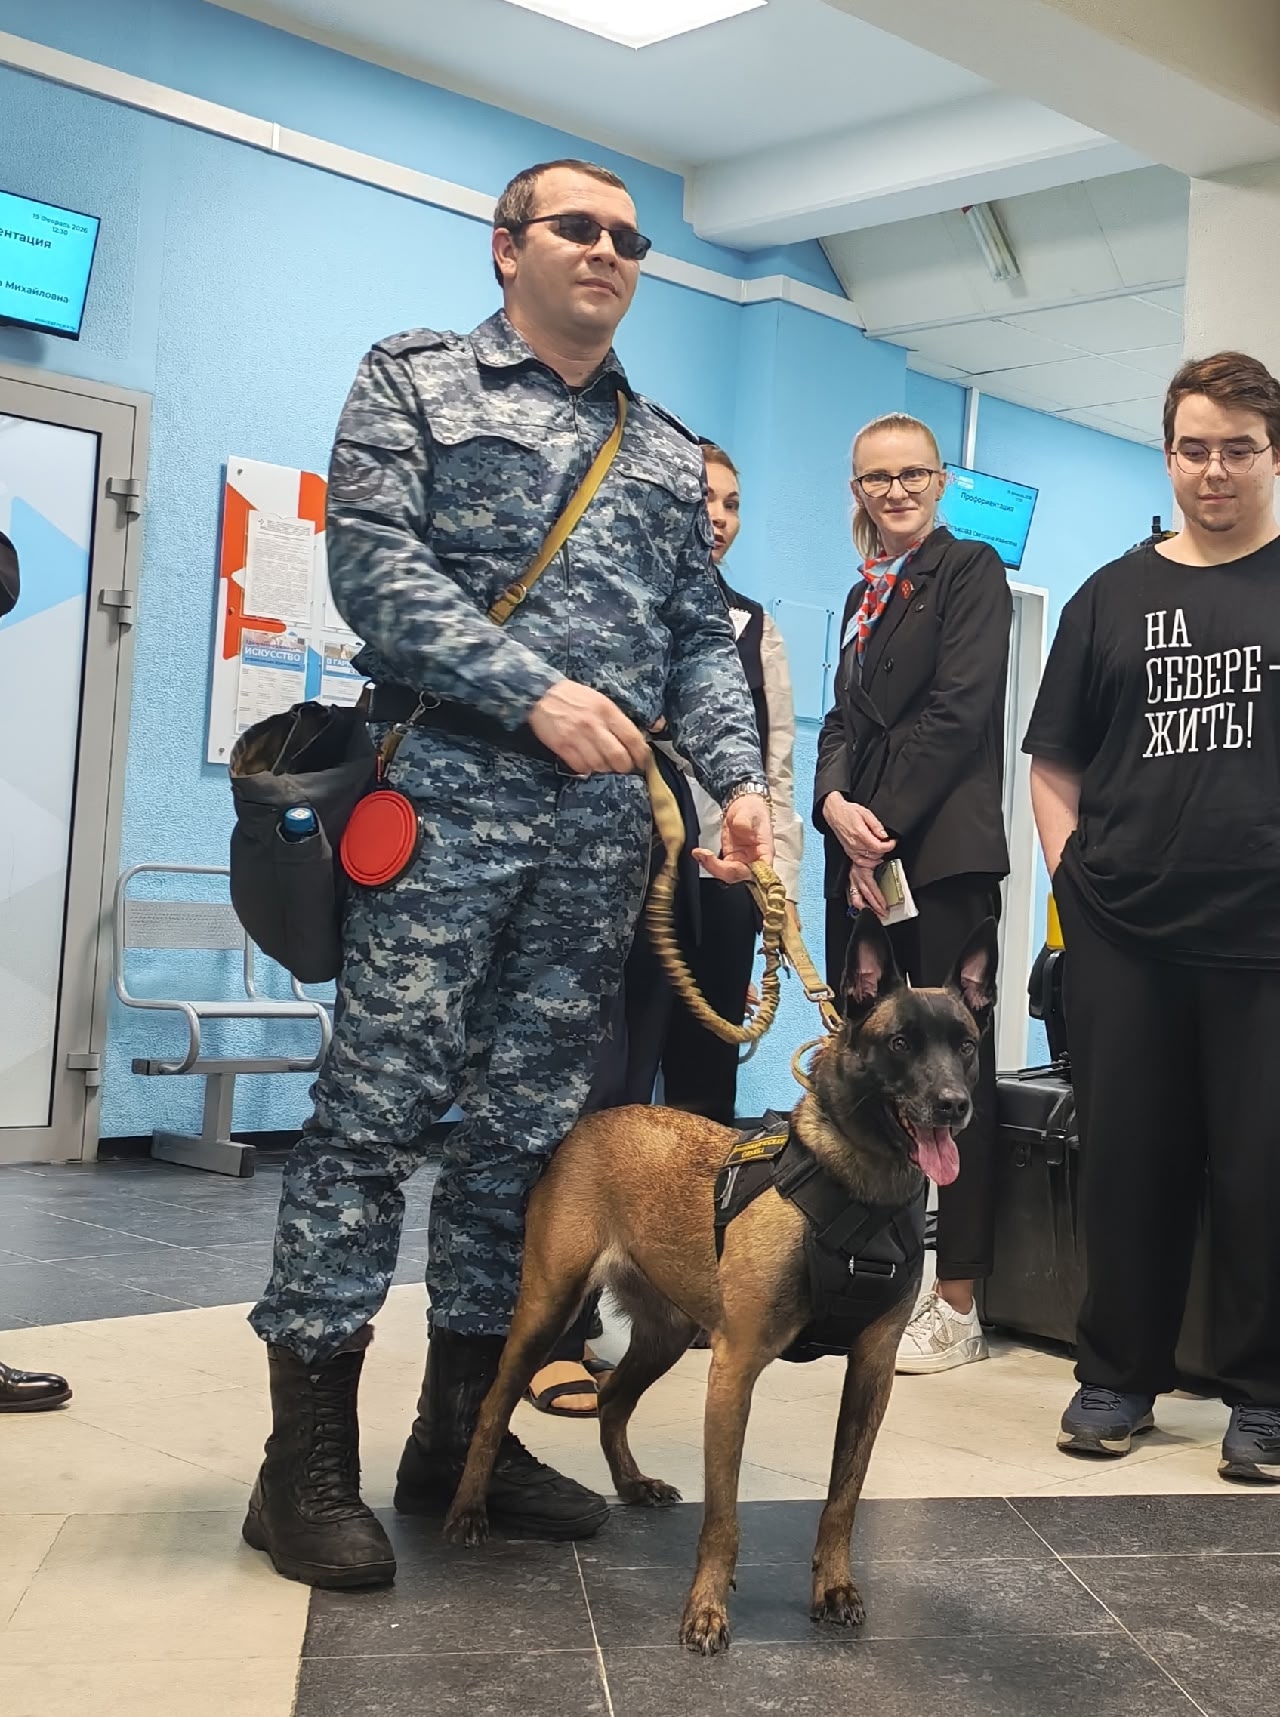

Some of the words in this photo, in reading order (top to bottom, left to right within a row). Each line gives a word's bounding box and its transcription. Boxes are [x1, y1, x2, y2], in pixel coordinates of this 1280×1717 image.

[71, 223, 89, 234] 2026
[5, 280, 70, 304] Михайловна
[1144, 608, 1193, 651] НА
[244, 647, 301, 662] ИСКУССТВО
[1146, 645, 1262, 704] СЕВЕРЕ
[1142, 701, 1253, 758] ЖИТЬ!
